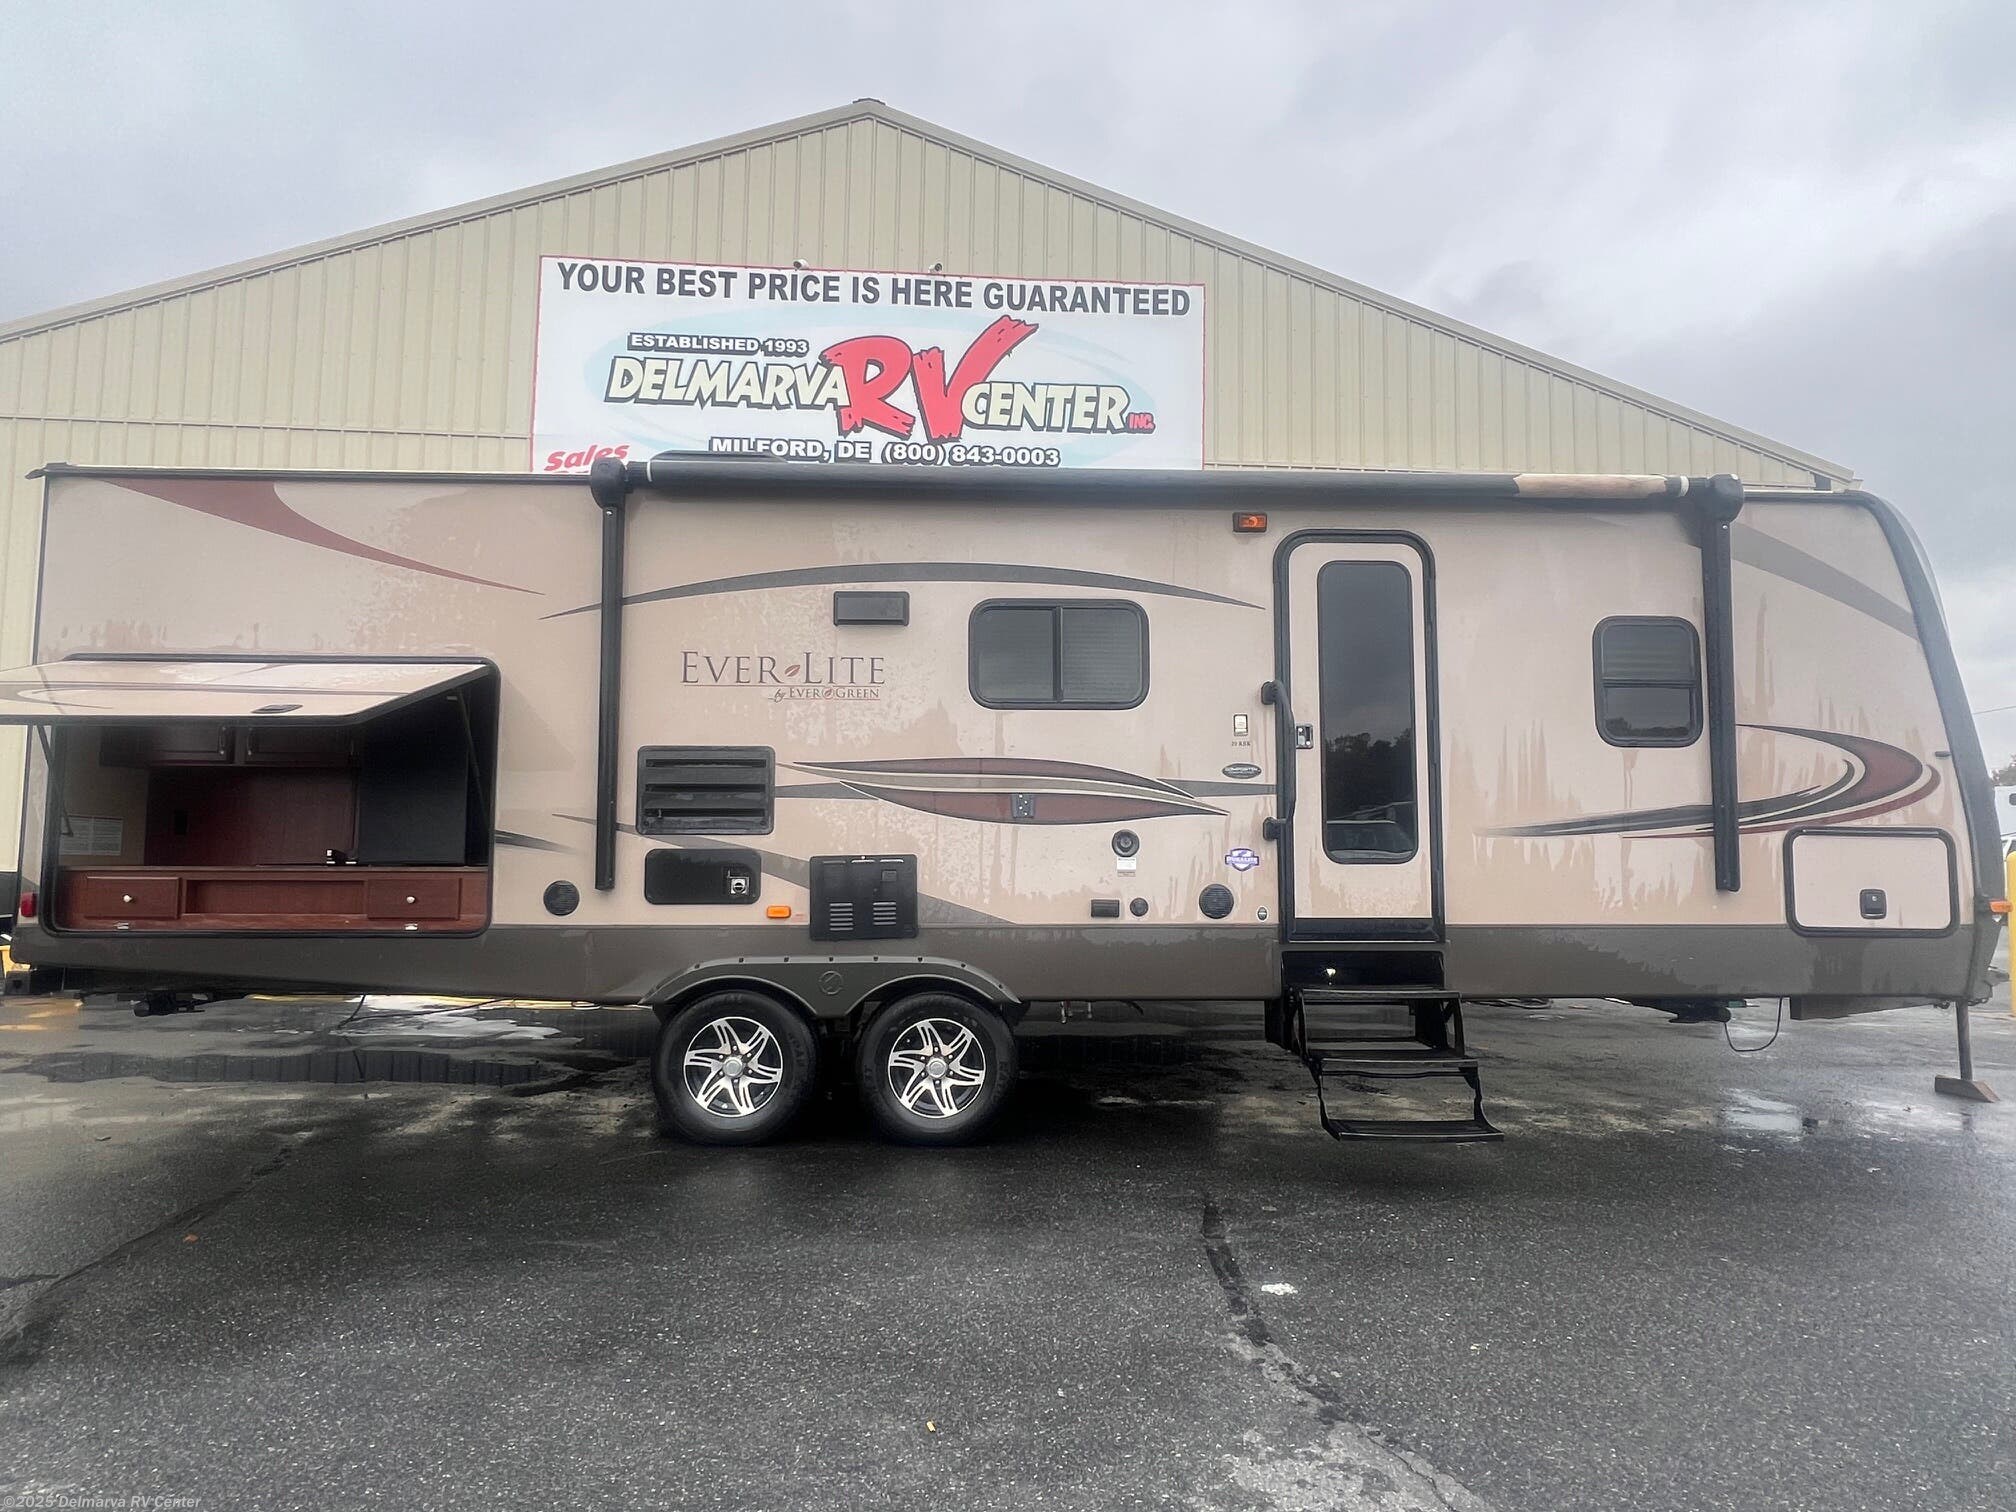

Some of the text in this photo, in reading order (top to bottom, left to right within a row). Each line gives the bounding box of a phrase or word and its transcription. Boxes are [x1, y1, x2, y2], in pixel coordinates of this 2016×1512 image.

[558, 262, 1191, 316] YOUR BEST PRICE IS HERE GUARANTEED
[629, 332, 809, 355] ESTABLISHED 1993
[604, 356, 851, 410] DELMARVA
[820, 315, 1039, 443] RV
[961, 381, 1130, 433] CENTER
[710, 436, 1061, 466] MILFORD, DE (800) 843-0003
[681, 651, 885, 685] EVER LITE
